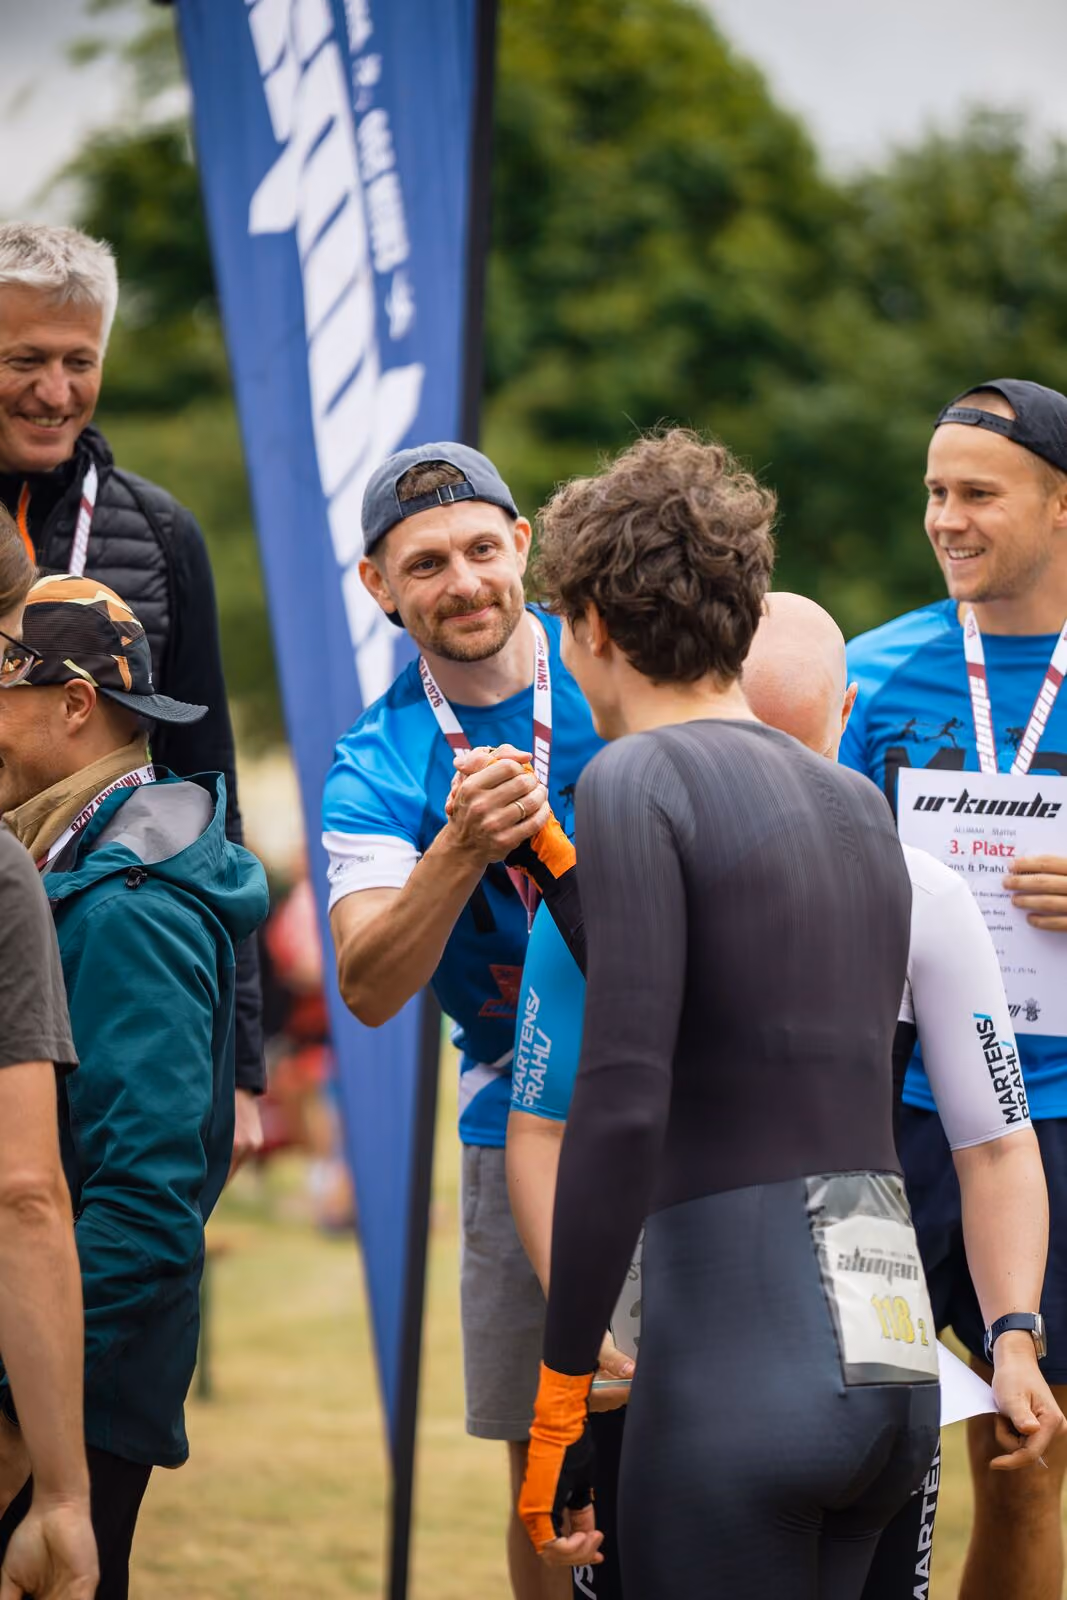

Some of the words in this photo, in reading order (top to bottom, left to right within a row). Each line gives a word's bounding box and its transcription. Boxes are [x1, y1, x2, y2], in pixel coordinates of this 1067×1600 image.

[537, 658, 548, 691] SWIM
[425, 678, 444, 708] 2026
[913, 788, 1063, 819] urkunde
[949, 839, 965, 855] 3.
[973, 841, 1016, 857] Platz
[979, 864, 1005, 873] Prahl
[871, 1294, 915, 1344] 118
[917, 1318, 930, 1346] 2
